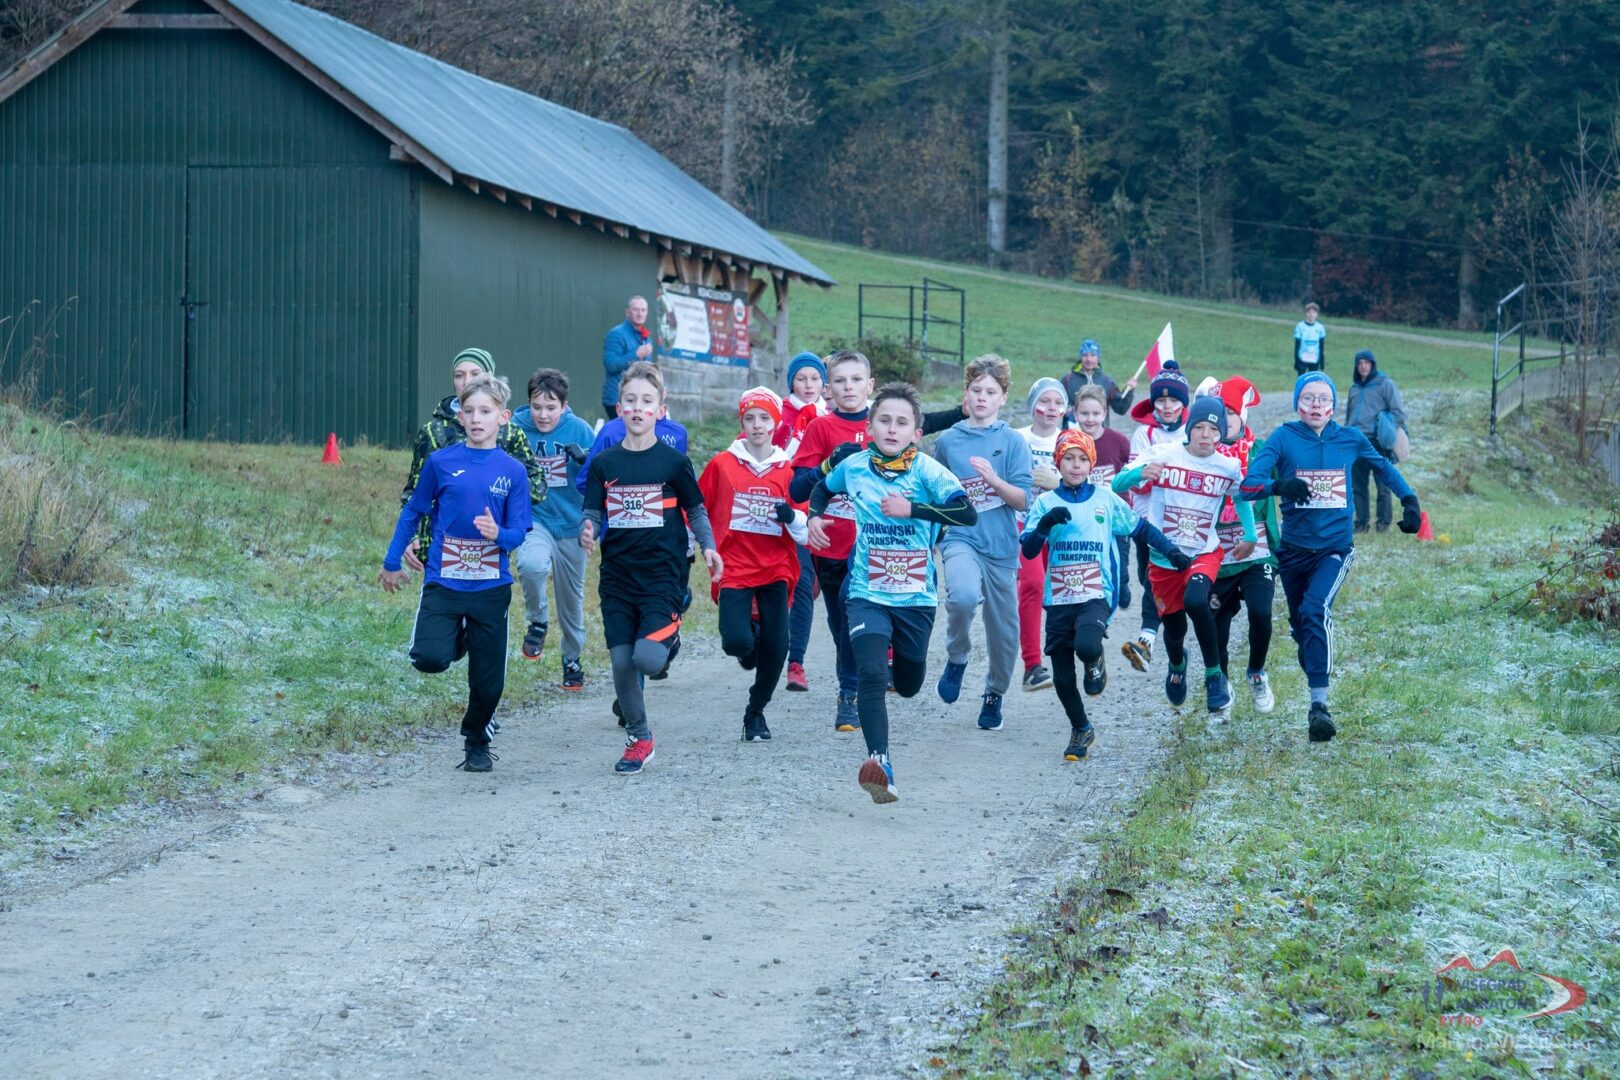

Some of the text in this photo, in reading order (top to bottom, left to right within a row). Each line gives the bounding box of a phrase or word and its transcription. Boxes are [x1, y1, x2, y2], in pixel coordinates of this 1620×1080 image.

[1314, 482, 1331, 492] 485
[624, 500, 642, 510] 316
[751, 507, 767, 517] 411
[1179, 520, 1196, 531] 465
[461, 553, 480, 563] 466
[1058, 553, 1097, 562] TRANSPORT
[887, 564, 906, 575] 426
[1065, 577, 1082, 587] 430
